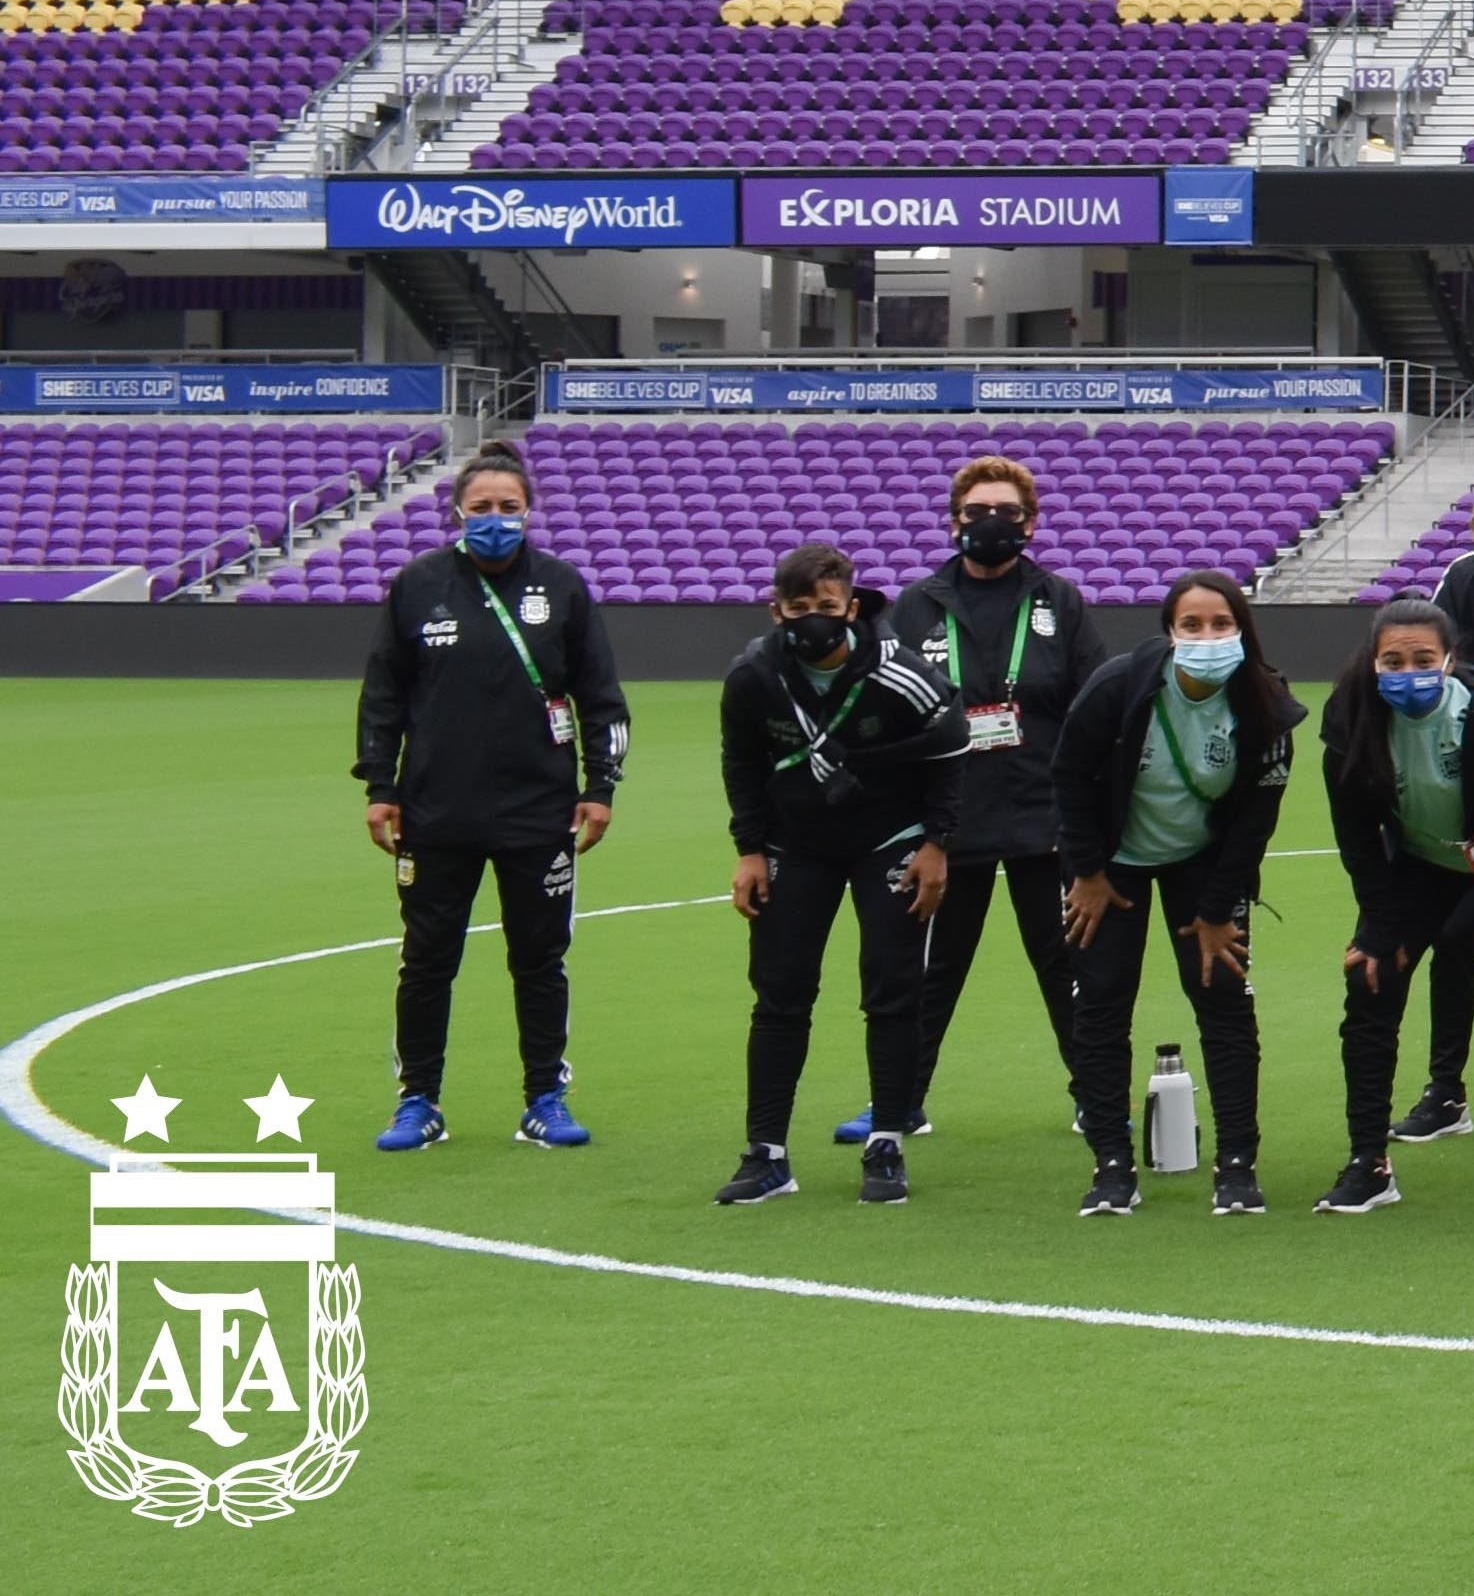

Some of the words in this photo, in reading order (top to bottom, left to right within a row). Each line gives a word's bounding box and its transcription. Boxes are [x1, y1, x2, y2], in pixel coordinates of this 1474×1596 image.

[456, 75, 491, 94] 132
[1357, 69, 1393, 88] 132
[40, 191, 69, 208] CUP
[78, 195, 117, 212] VISA
[151, 197, 217, 216] pursue
[219, 190, 253, 209] YOUR
[254, 190, 308, 210] PASSION
[587, 196, 677, 229] World
[779, 189, 959, 228] EXPLORIA
[979, 196, 1121, 227] STADIUM
[143, 380, 173, 397] CUP
[185, 385, 226, 402] VISA
[249, 380, 313, 401] inspire
[315, 377, 389, 396] CONFIDENCE
[667, 382, 700, 399] CUP
[710, 387, 753, 404] VISA
[787, 386, 846, 406] aspire
[848, 382, 866, 401] TO
[866, 382, 938, 401] GREATNESS
[1085, 382, 1119, 399] CUP
[1128, 387, 1173, 404] VISA
[1204, 385, 1270, 404] pursue
[1272, 380, 1307, 398] YOUR
[1308, 379, 1361, 398] PASSION
[424, 635, 459, 646] YPF
